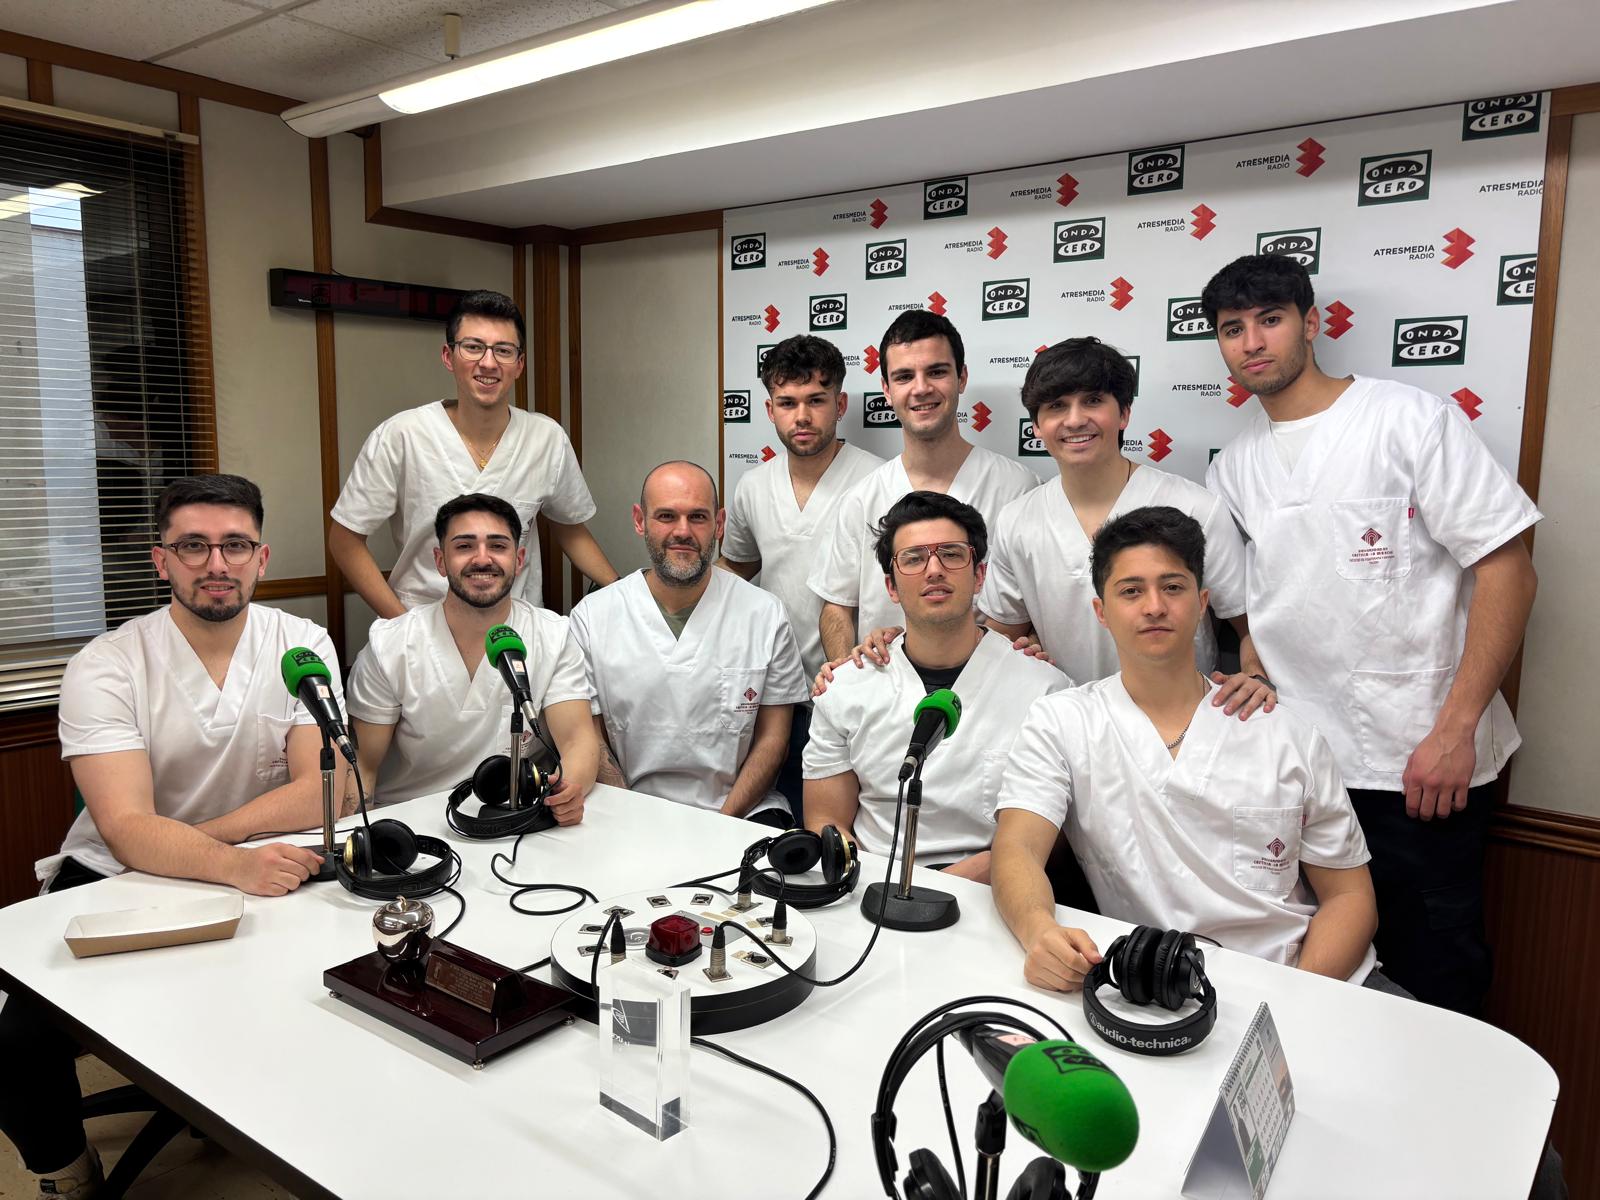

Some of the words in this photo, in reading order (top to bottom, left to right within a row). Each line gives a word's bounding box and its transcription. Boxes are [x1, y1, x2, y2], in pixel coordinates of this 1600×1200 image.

[1478, 113, 1526, 128] CERO
[1138, 157, 1174, 170] ONDA
[1236, 154, 1290, 168] ATRESMEDIA
[1267, 162, 1290, 170] RADIO
[1371, 164, 1418, 178] ONDA
[1138, 172, 1173, 184] CERO
[931, 187, 960, 198] ONDA
[1010, 187, 1052, 198] ATRESMEDIA
[1373, 180, 1417, 194] CERO
[932, 200, 960, 210] CERO
[832, 210, 866, 220] ATRESMEDIA
[1137, 218, 1185, 229] ATRESMEDIA
[1062, 227, 1096, 238] ONDA
[736, 242, 760, 251] ONDA
[944, 240, 983, 250] ATRESMEDIA
[1064, 242, 1096, 253] CERO
[1267, 241, 1308, 252] ONDA
[1374, 244, 1434, 256] ATRESMEDIA
[738, 254, 760, 262] CERO
[872, 249, 900, 259] ONDA
[1408, 252, 1434, 260] RADIO
[778, 258, 810, 267] ATRESMEDIA
[874, 262, 900, 272] CERO
[1512, 266, 1536, 276] ON
[990, 288, 1021, 298] ONDA
[1514, 282, 1534, 294] CE
[1061, 290, 1105, 298] ATRESMEDIA
[816, 302, 841, 311] ONDA
[992, 300, 1021, 312] CERO
[732, 314, 761, 322] ATRESMEDIA
[816, 313, 841, 324] CERO
[1406, 328, 1452, 339] ONDA
[1408, 345, 1452, 356] CERO
[1028, 440, 1042, 448] CE
[1096, 1024, 1187, 1048] audio-technica
